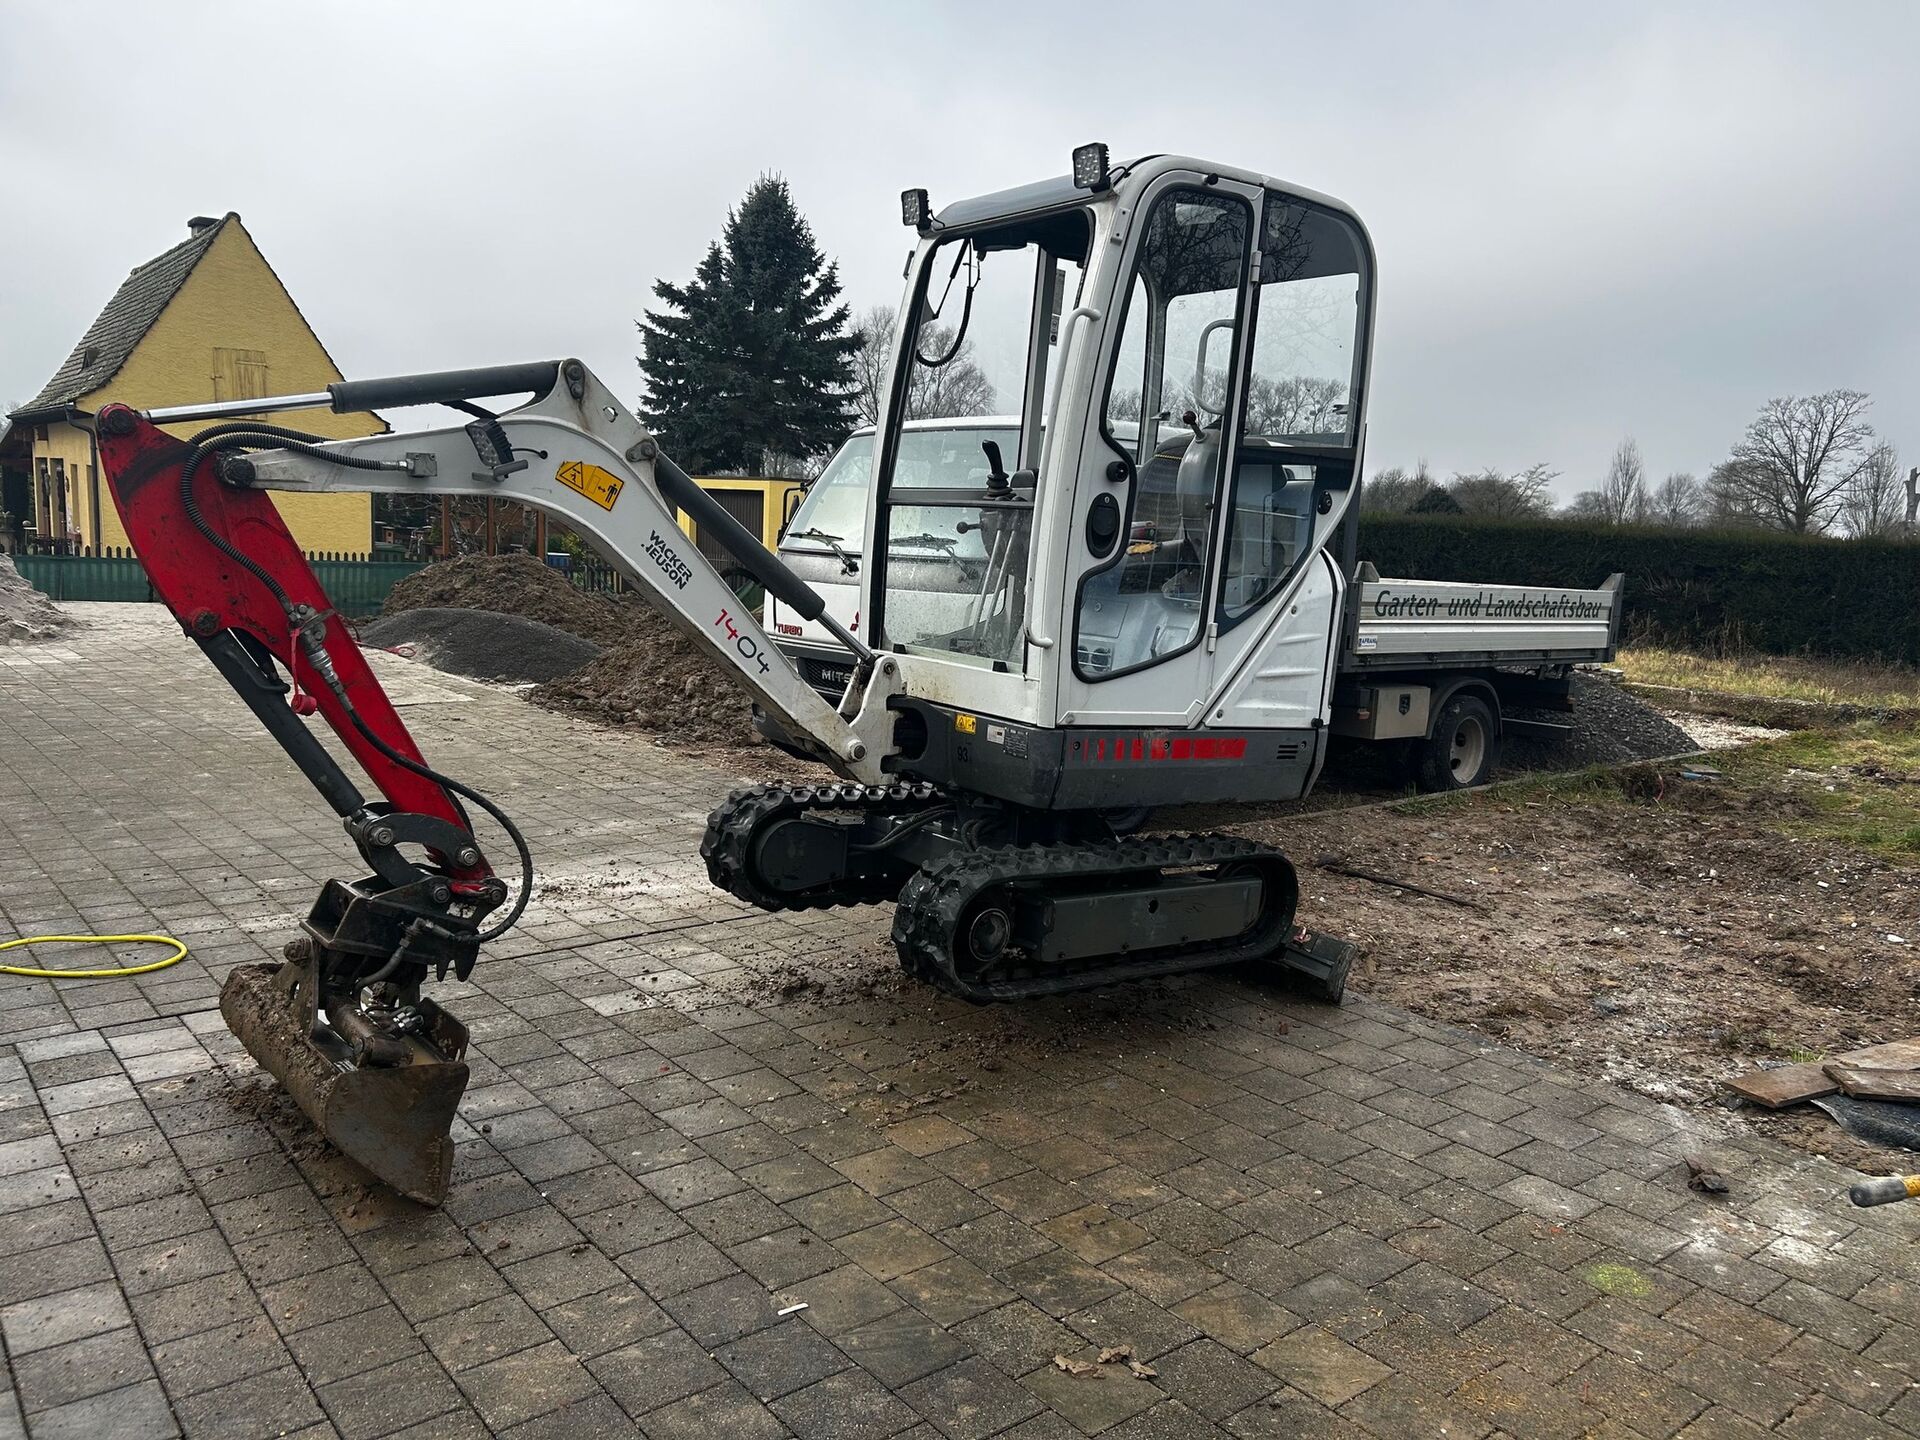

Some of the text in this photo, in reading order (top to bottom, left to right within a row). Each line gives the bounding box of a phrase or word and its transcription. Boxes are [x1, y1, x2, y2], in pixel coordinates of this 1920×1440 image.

[650, 530, 692, 581] WACKER
[1374, 590, 1602, 618] Garten- und Landschaftsbau
[715, 608, 770, 674] 1404
[777, 623, 803, 636] TURBO
